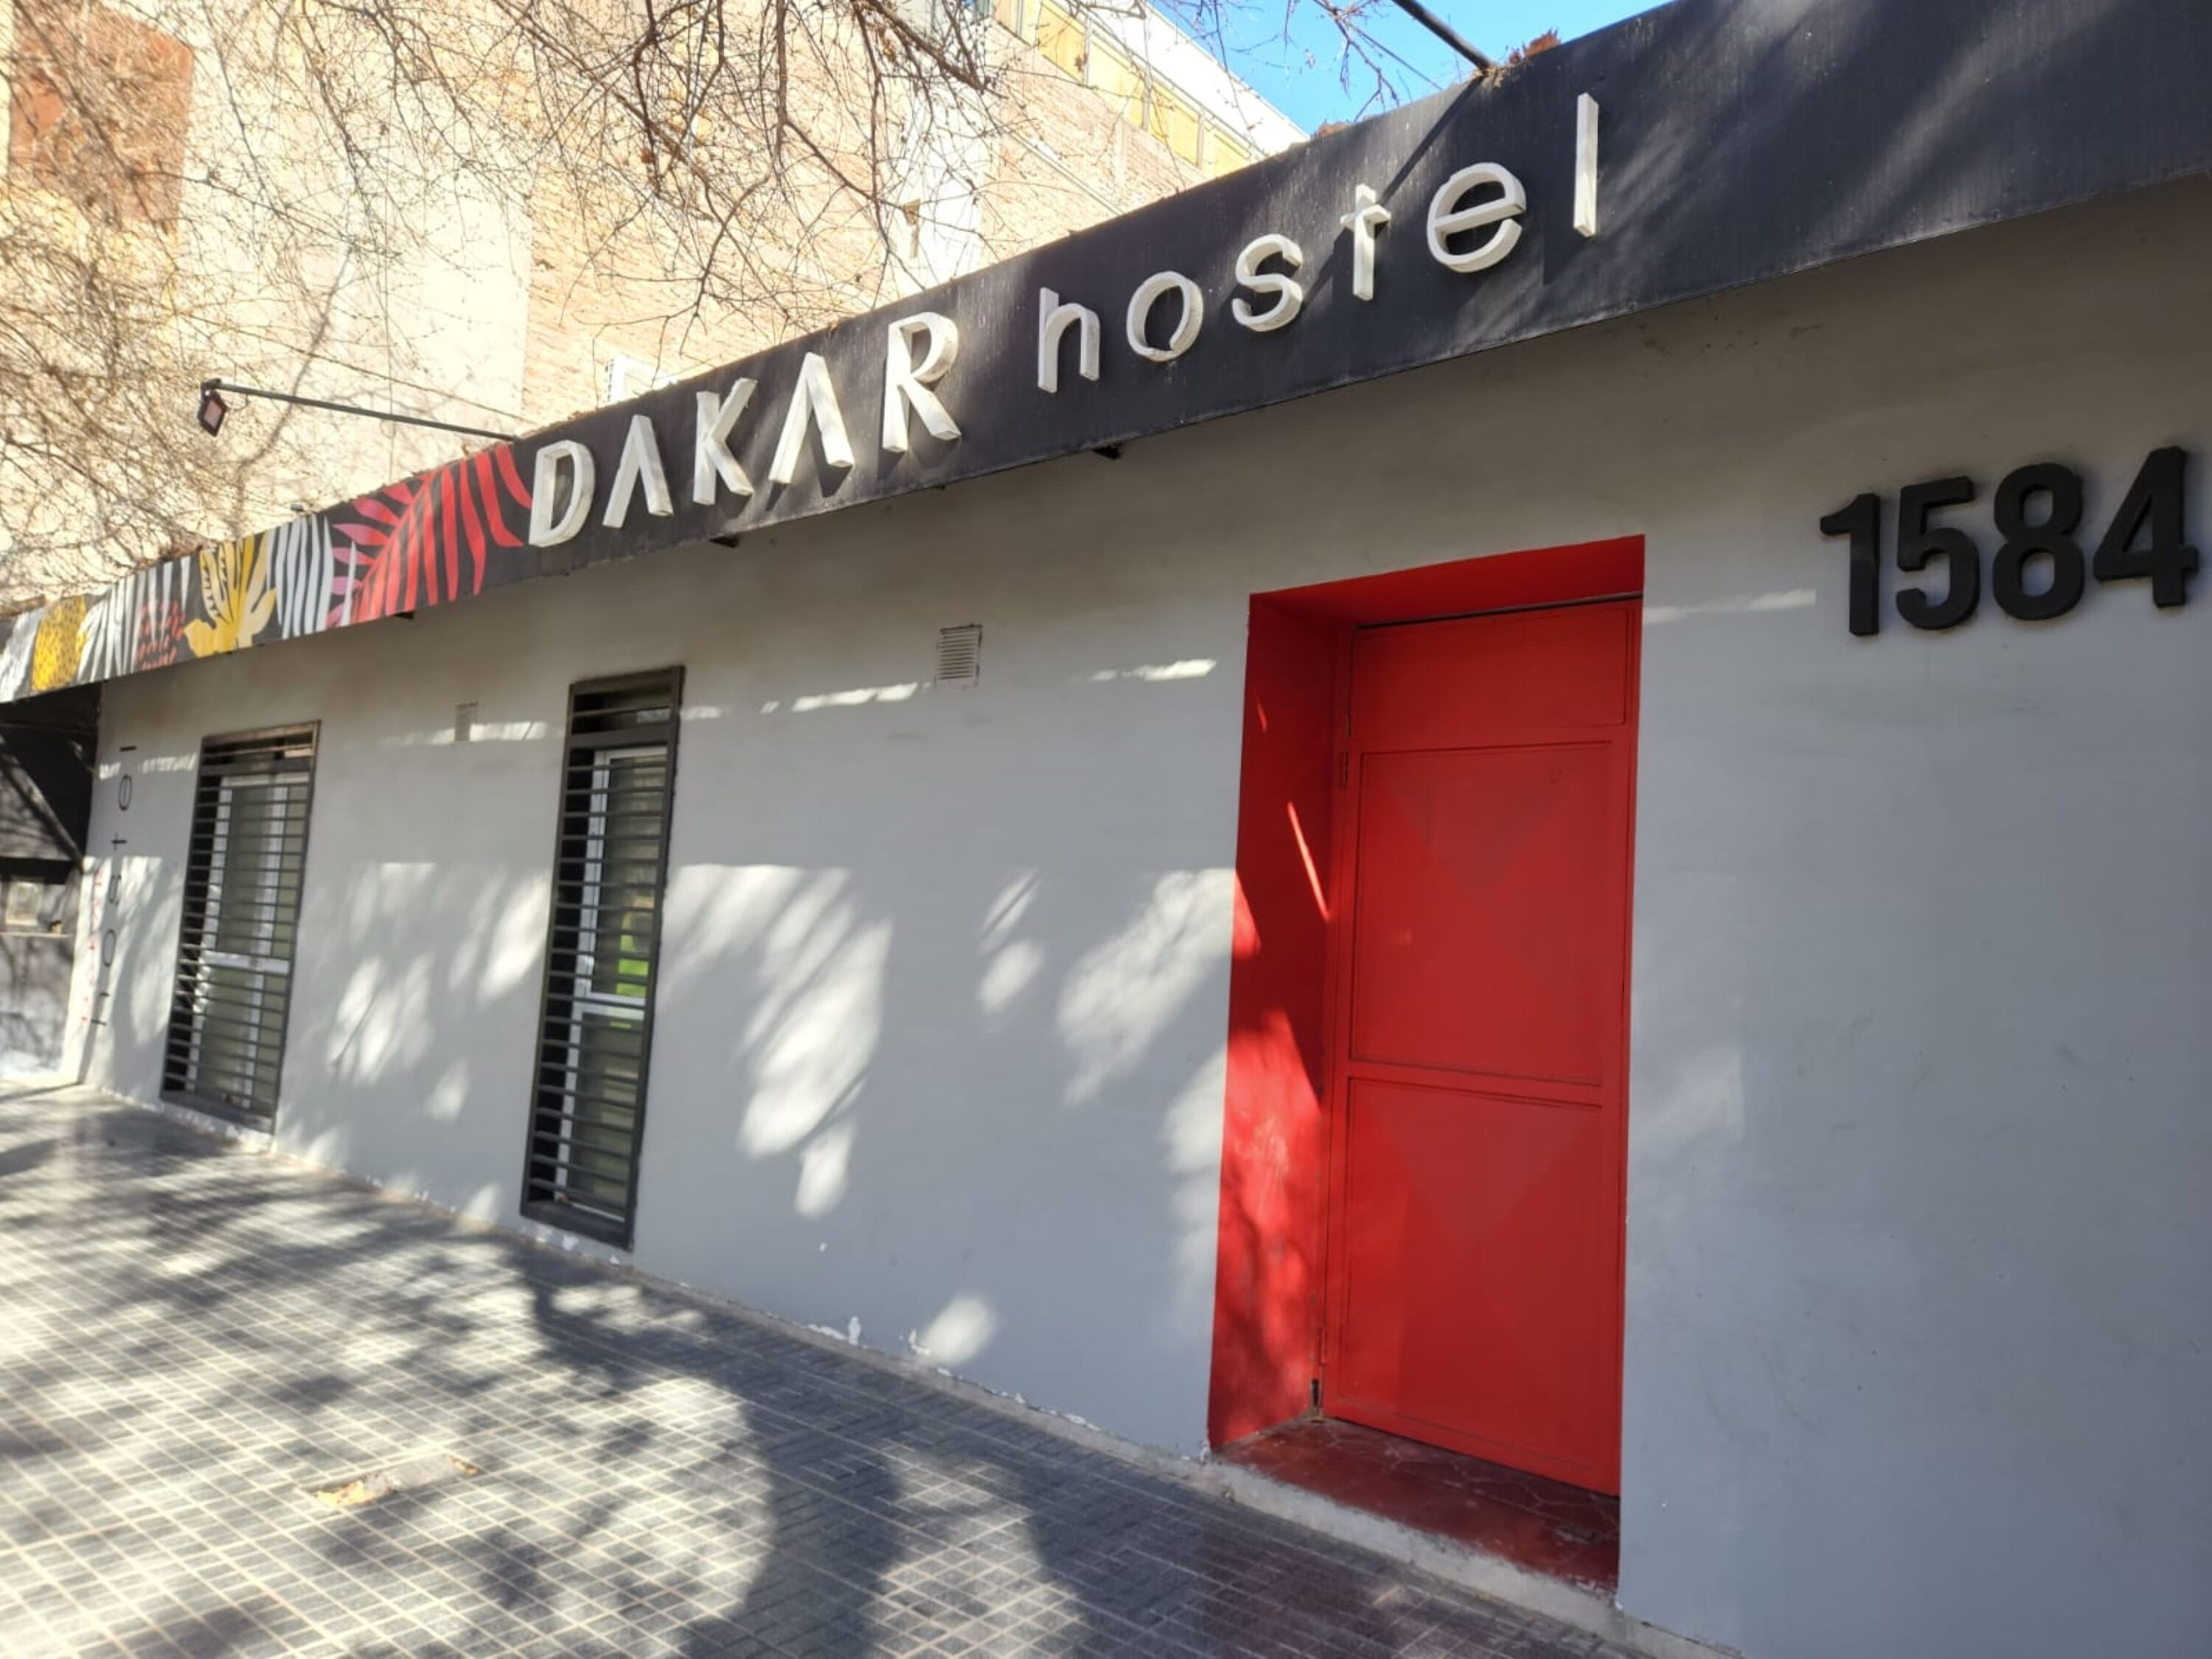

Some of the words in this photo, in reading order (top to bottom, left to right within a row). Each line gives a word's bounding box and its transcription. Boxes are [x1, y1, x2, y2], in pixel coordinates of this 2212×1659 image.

[529, 311, 961, 548] DAKAR
[1037, 93, 1600, 394] hostel
[1820, 445, 2199, 636] 1584
